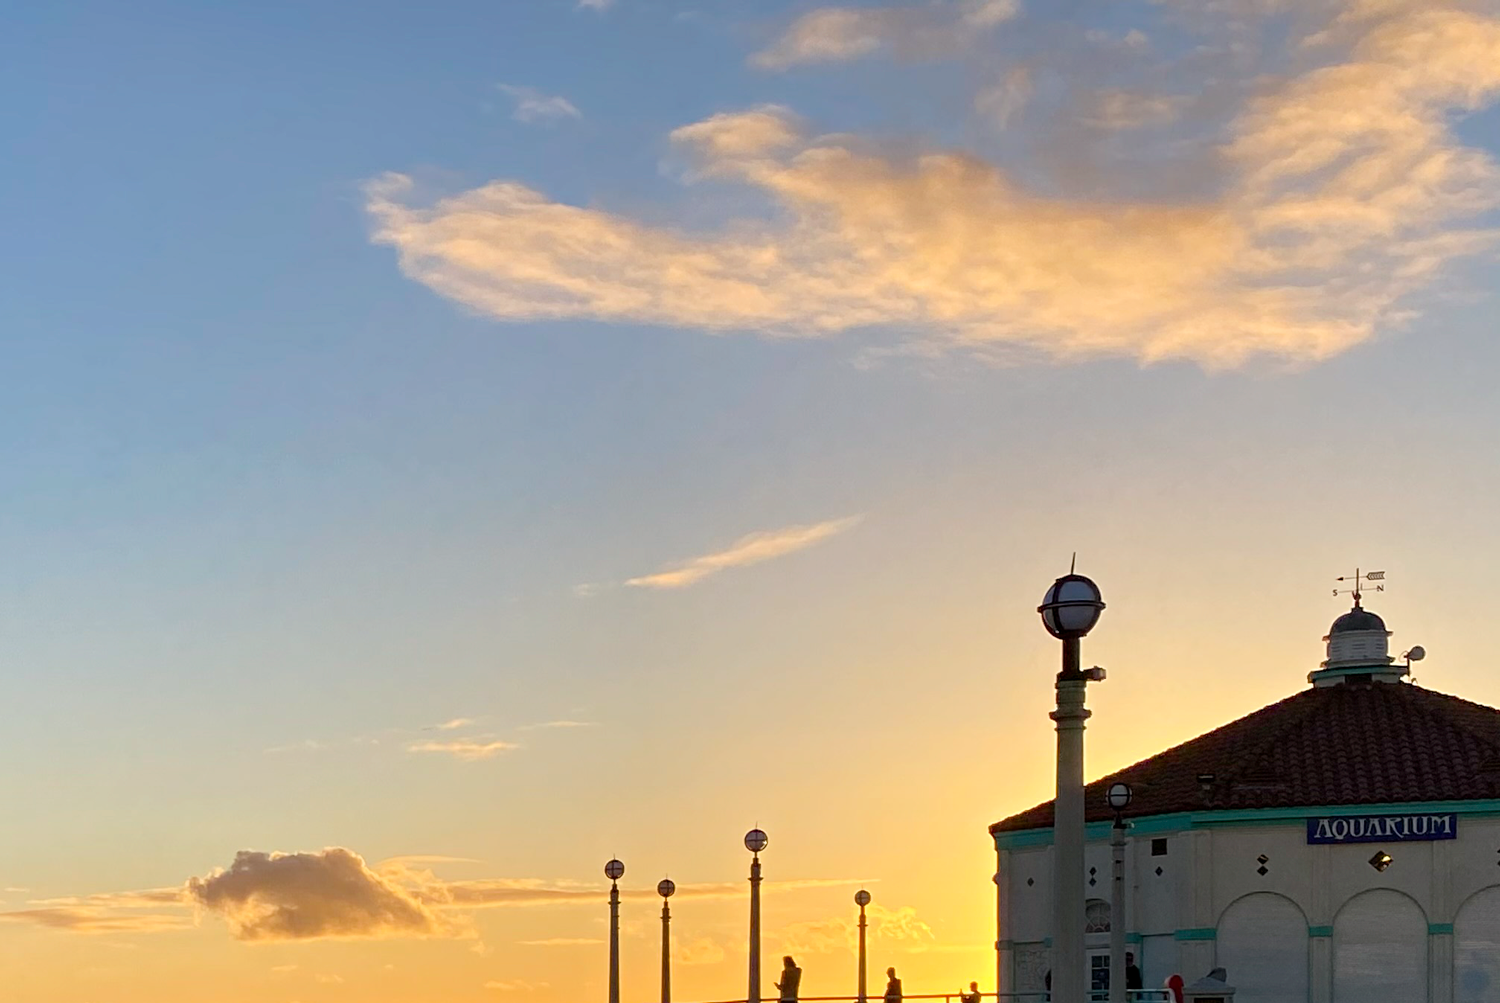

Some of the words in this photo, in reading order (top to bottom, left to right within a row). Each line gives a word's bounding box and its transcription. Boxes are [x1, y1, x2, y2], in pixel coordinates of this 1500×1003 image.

[1376, 584, 1384, 592] N
[1332, 589, 1338, 597] S
[1314, 815, 1451, 840] AQUARIUM
